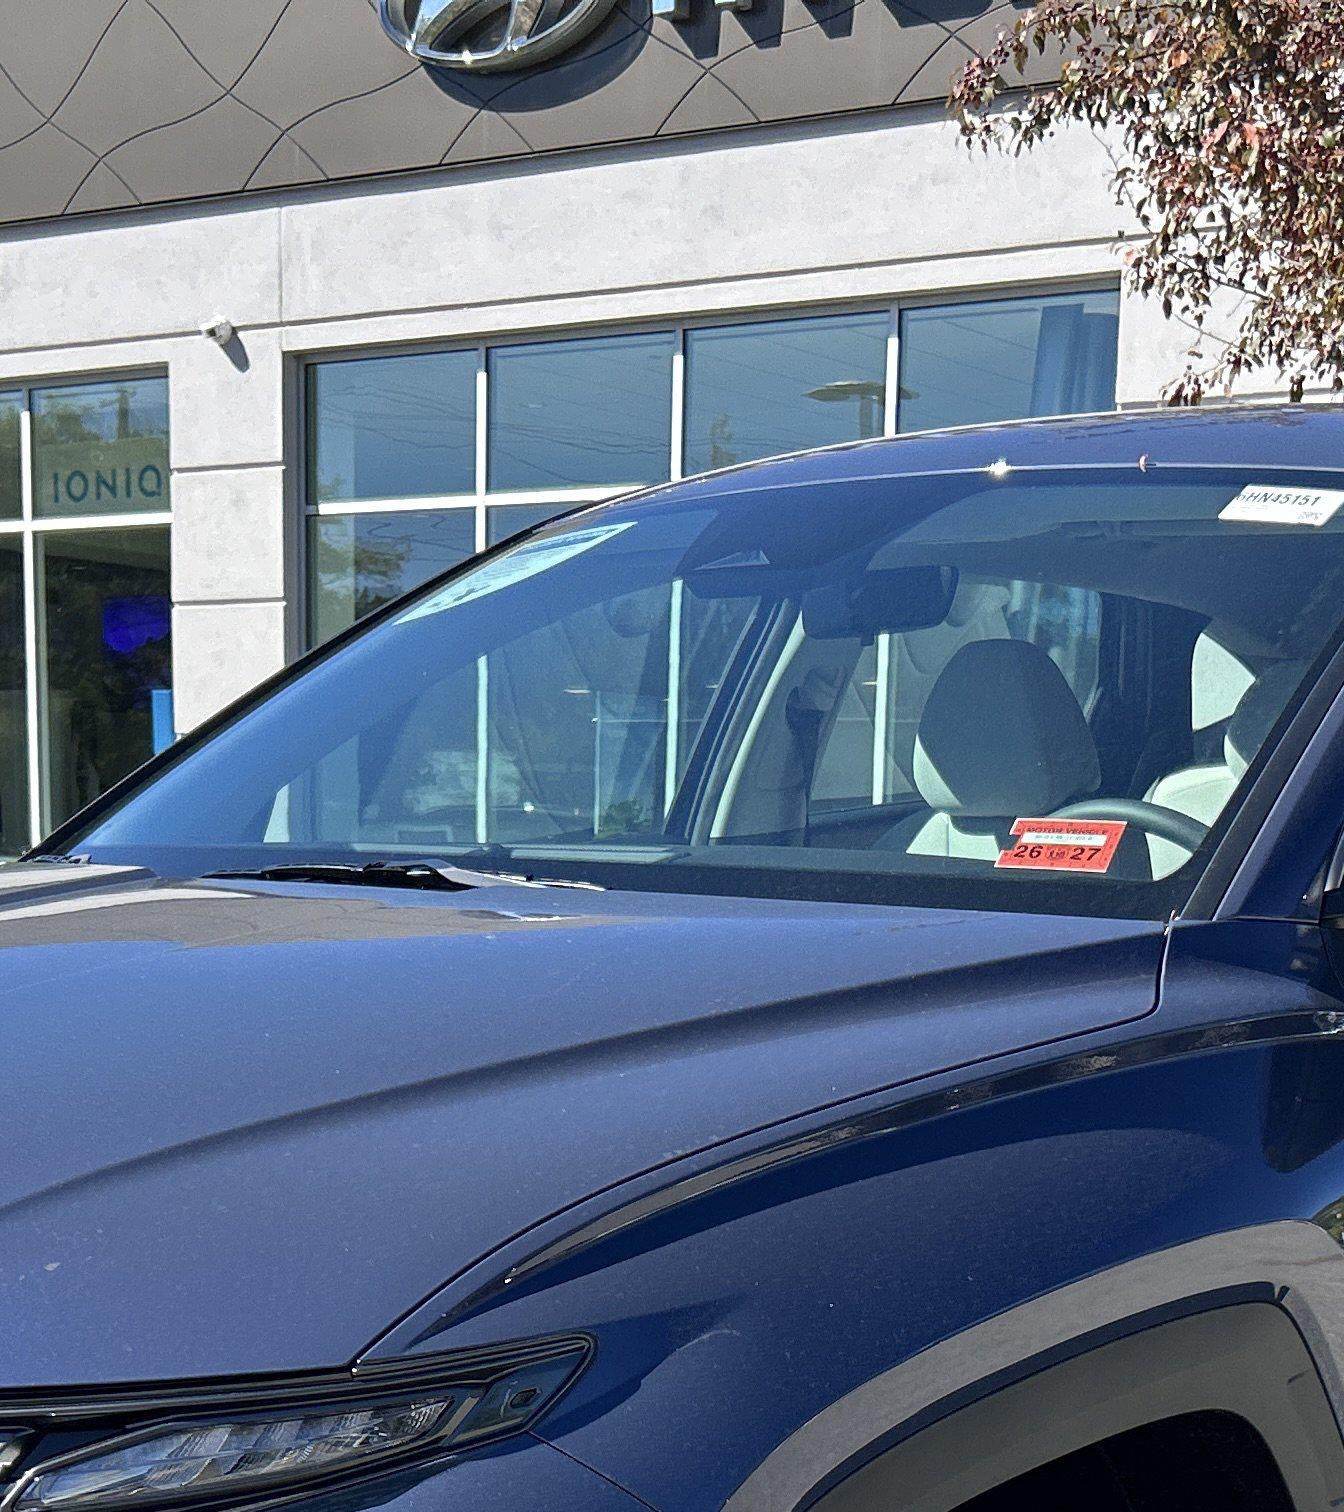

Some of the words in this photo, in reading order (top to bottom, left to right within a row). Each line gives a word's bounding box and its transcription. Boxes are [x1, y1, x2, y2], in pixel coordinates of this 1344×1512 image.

[52, 465, 163, 503] IONIQ
[1013, 845, 1044, 859] 26
[1069, 847, 1102, 861] 27
